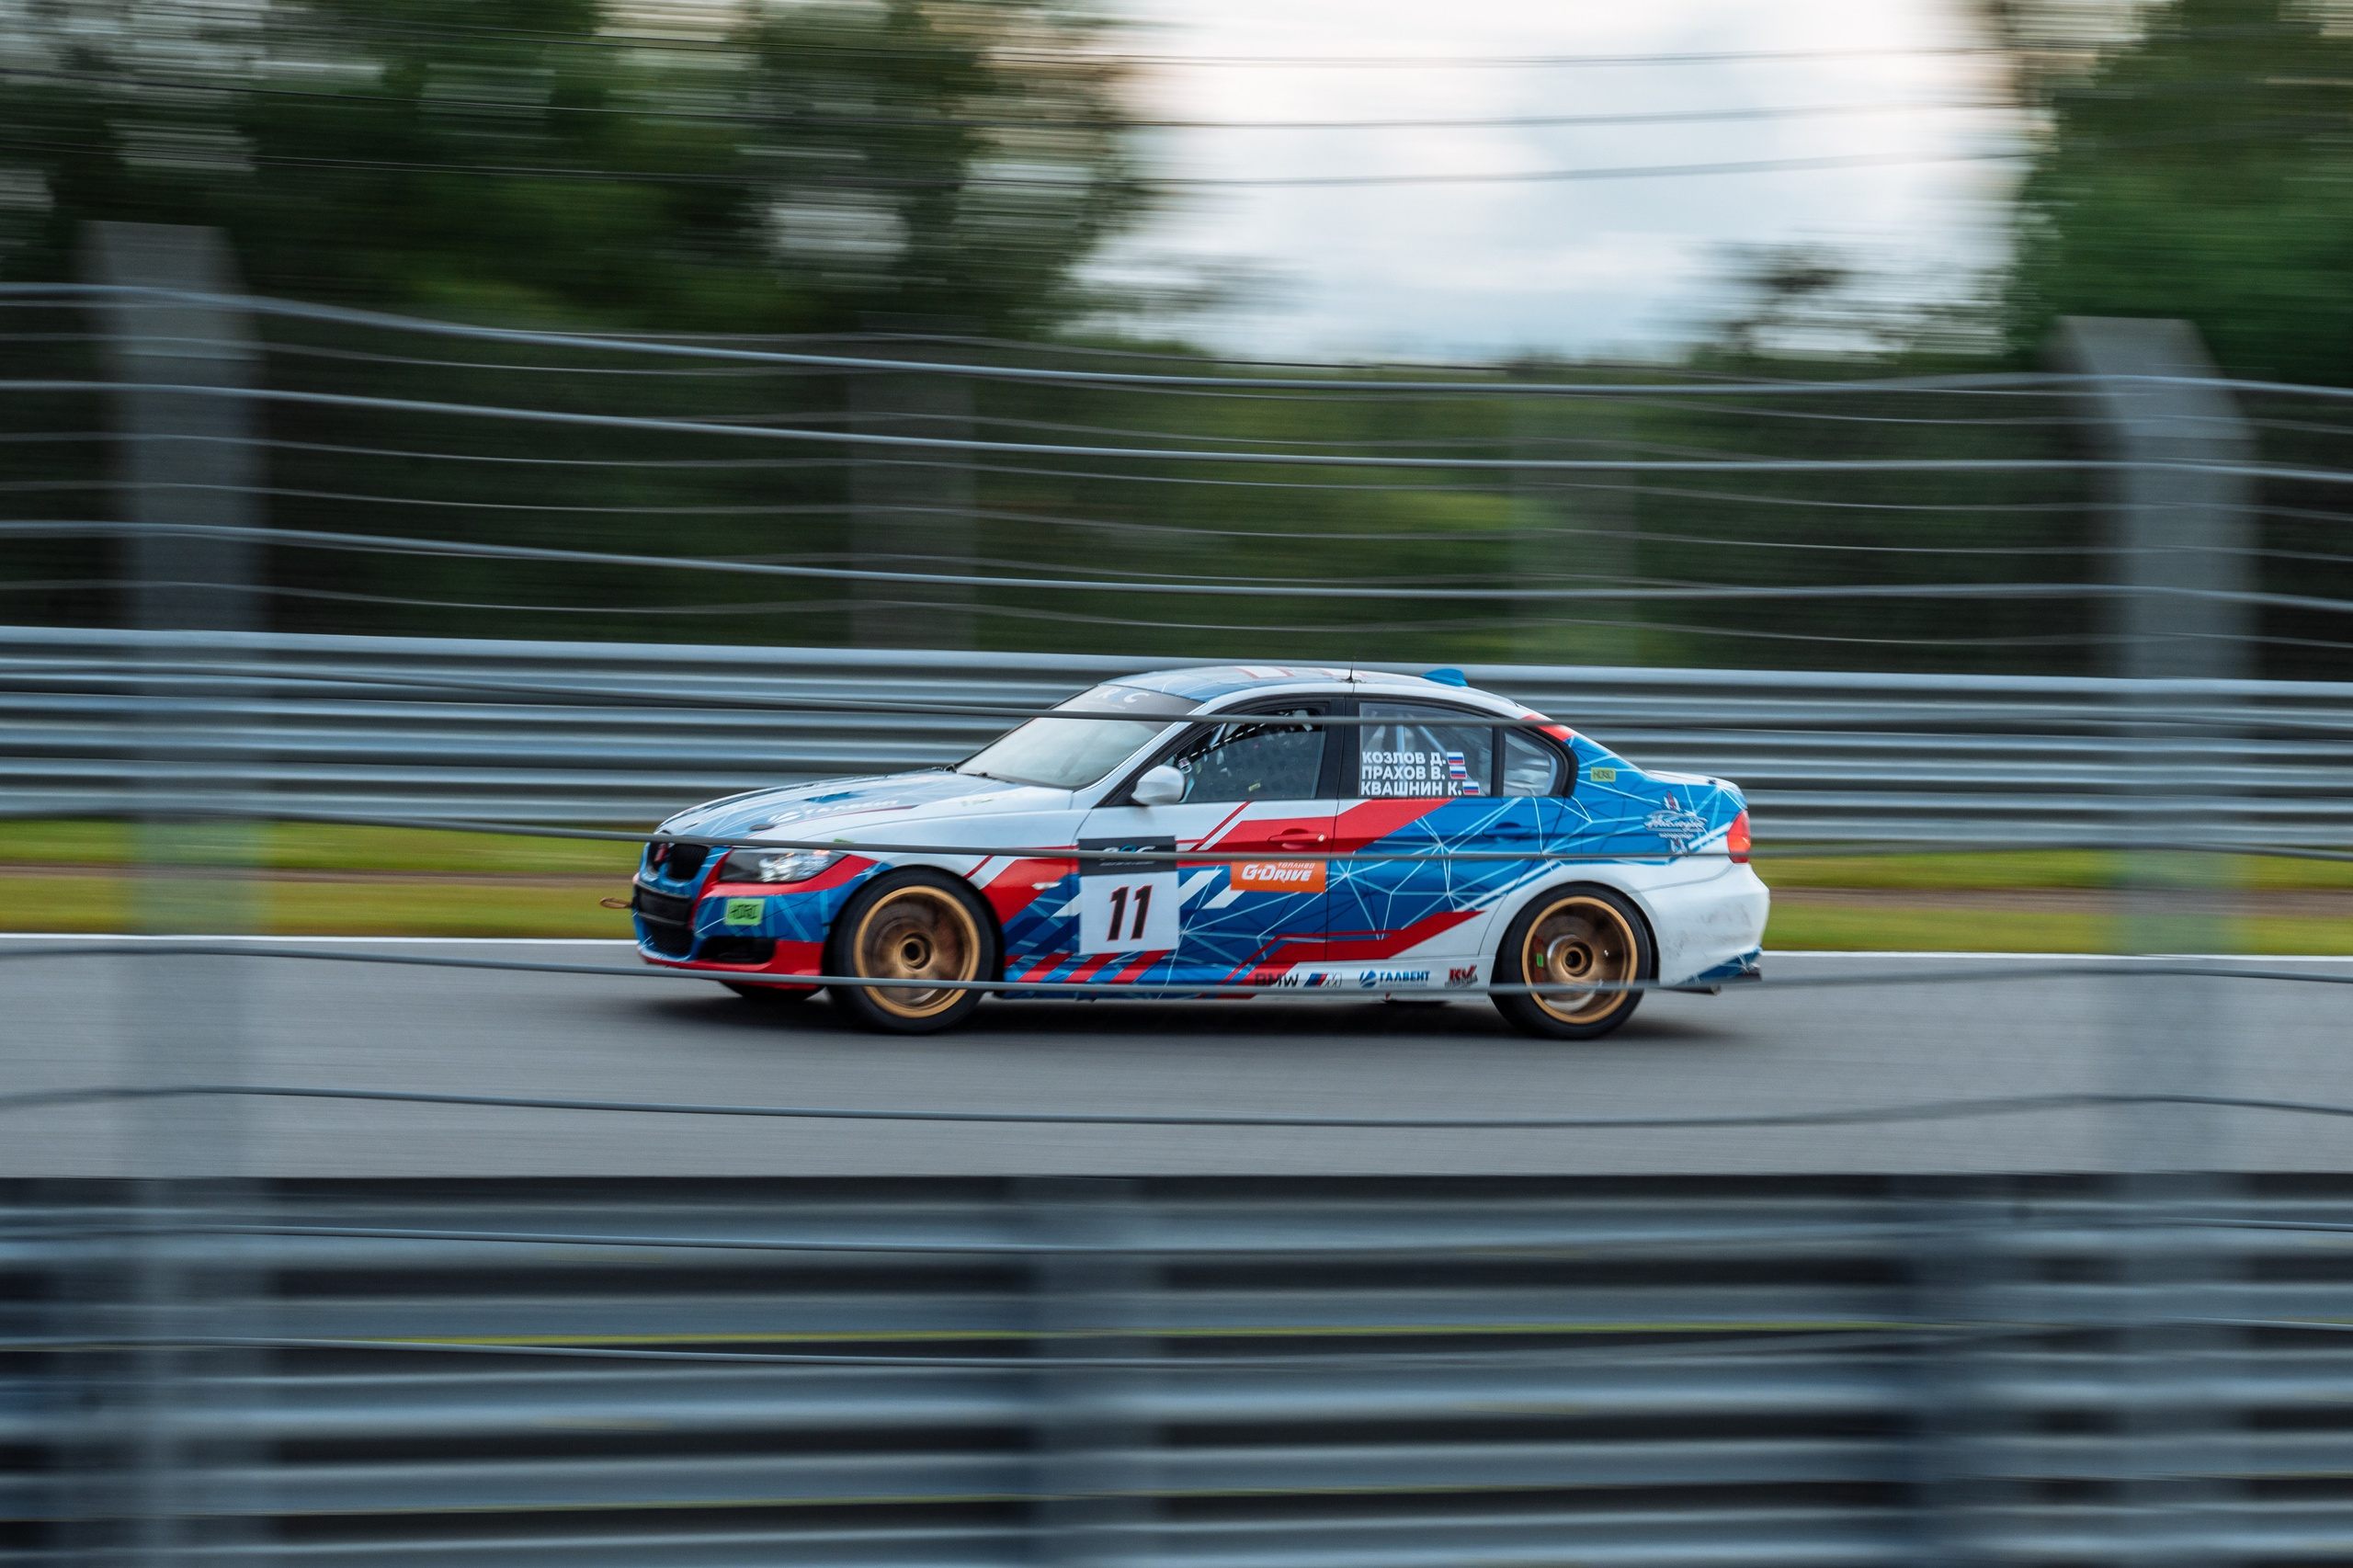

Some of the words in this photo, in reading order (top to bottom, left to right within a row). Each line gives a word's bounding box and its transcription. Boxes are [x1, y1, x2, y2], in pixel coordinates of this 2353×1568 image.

[1361, 751, 1426, 765] КОЗЛОВ
[1430, 752, 1446, 767] Д.
[1361, 766, 1426, 780] ПРАХОВ
[1430, 766, 1446, 780] В.
[1360, 781, 1443, 796] КВАШНИН
[1447, 781, 1462, 796] К.
[1106, 884, 1154, 942] 11
[1254, 972, 1299, 988] BMW
[1379, 971, 1430, 983] ГАЛВЕНТ
